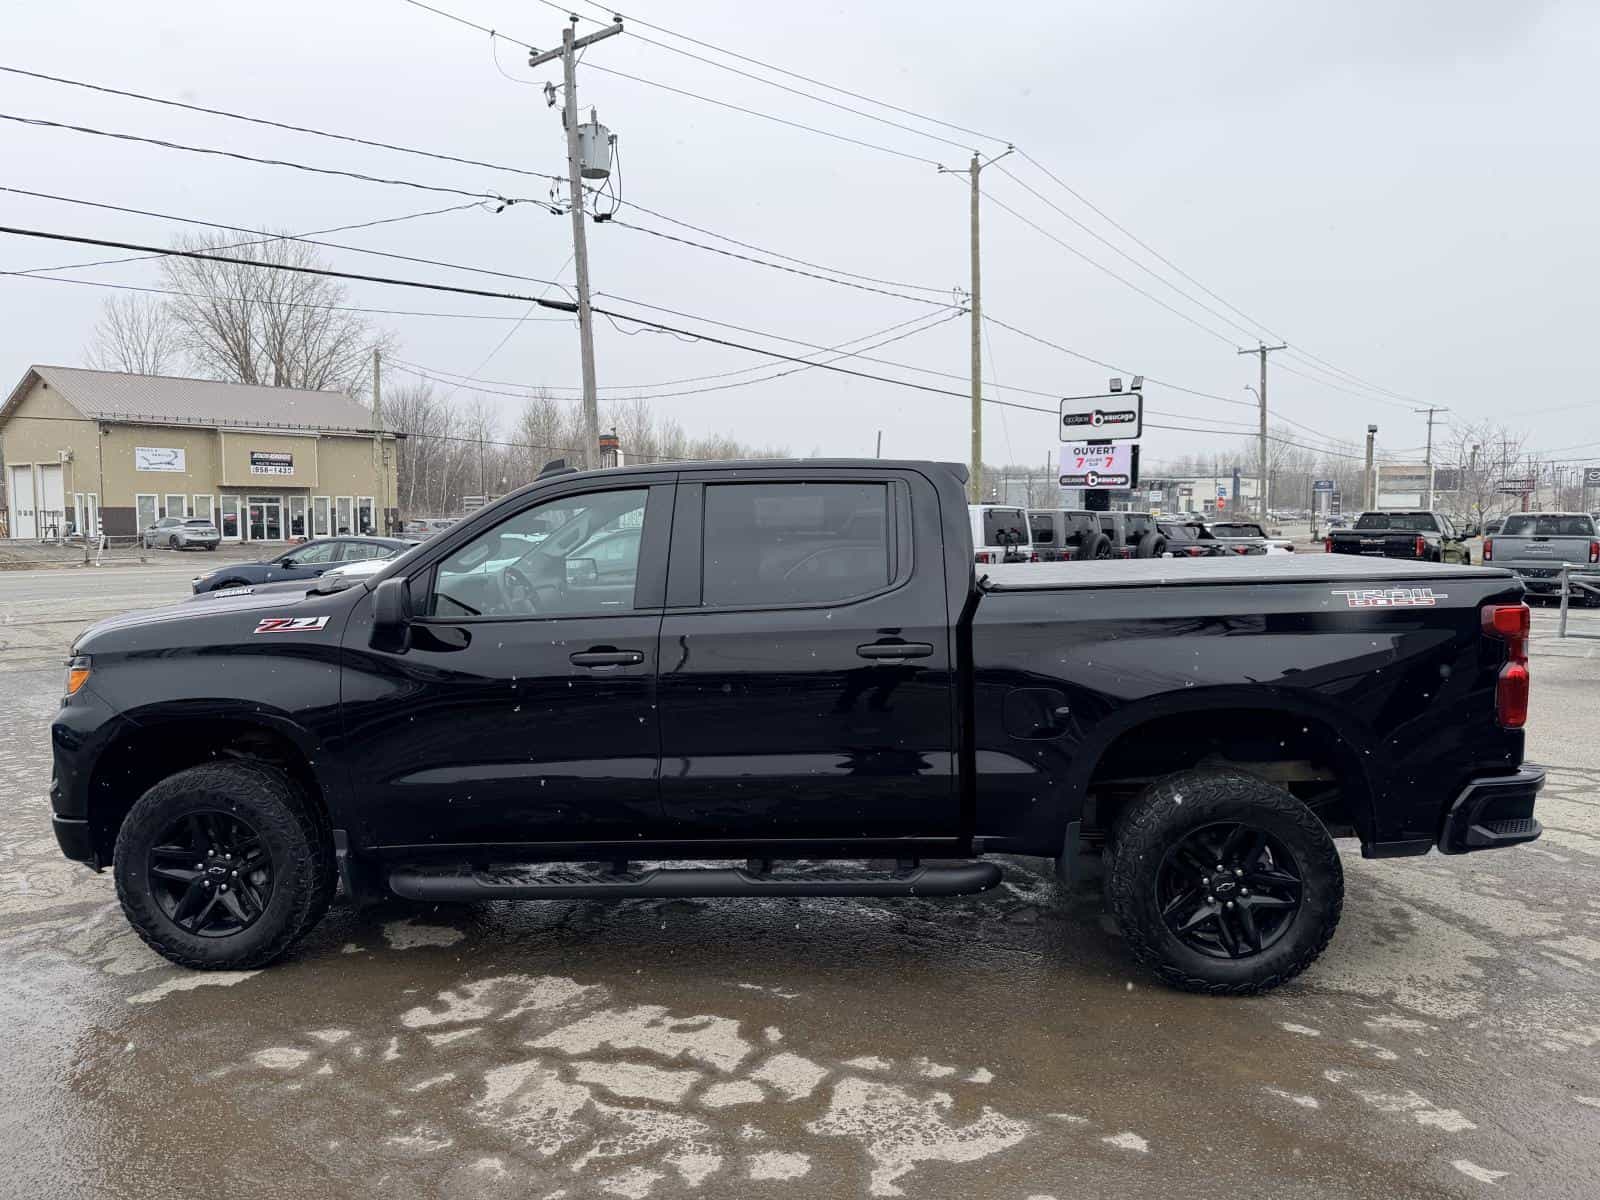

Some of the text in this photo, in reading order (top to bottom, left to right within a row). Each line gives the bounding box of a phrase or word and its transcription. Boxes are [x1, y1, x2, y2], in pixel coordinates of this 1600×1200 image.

[1073, 446, 1116, 456] OUVERT
[1075, 457, 1085, 468] 7
[1104, 456, 1113, 468] 7
[253, 615, 331, 634] Z71
